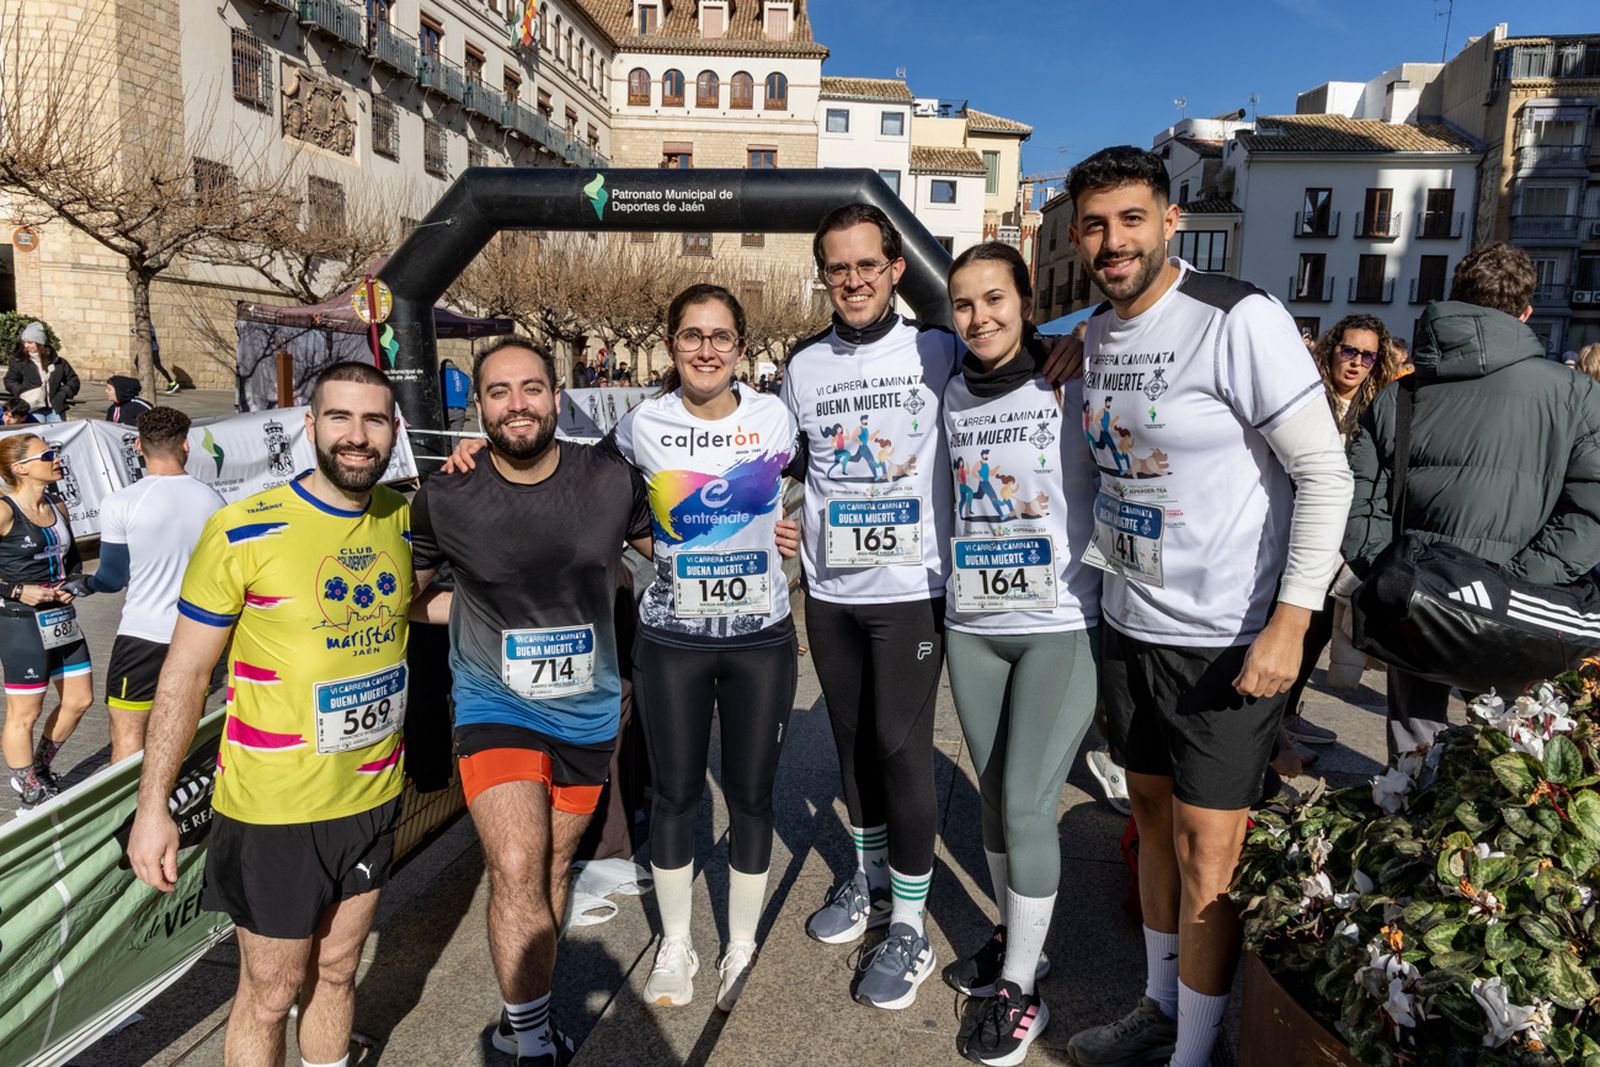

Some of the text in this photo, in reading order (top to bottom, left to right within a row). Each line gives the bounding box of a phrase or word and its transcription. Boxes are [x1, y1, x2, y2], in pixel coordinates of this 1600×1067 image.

[612, 188, 734, 202] Patronato Municipal de
[612, 201, 705, 214] Deportes de Jaén
[1122, 351, 1176, 366] CAMINATA
[816, 374, 924, 396] VI CARRERA CAMINATA
[1102, 372, 1145, 391] MUERTE
[816, 392, 901, 417] BUENA MUERTE
[956, 408, 1058, 428] CARRERA CAMINATA
[660, 426, 760, 456] calderón
[976, 426, 1028, 445] MUERTE
[877, 502, 910, 510] CAMINATA
[683, 511, 750, 525] entrénate
[838, 512, 896, 524] BUENA MUERTE
[852, 526, 897, 551] 165
[340, 546, 373, 555] CLUB
[972, 544, 1001, 552] CARRERA
[1002, 541, 1040, 550] CAMINATA
[725, 554, 758, 562] CAMINATA
[965, 552, 1025, 566] BUENA MUERTE
[686, 564, 744, 576] BUENA MUERTE
[979, 568, 1028, 595] 164
[699, 577, 747, 602] 140
[54, 621, 72, 638] 687
[326, 622, 397, 650] maristas
[523, 634, 555, 643] CARRERA
[555, 632, 586, 642] CAMINATA
[352, 648, 380, 656] JAÉN
[516, 642, 573, 656] BUENA MUERTE
[531, 657, 574, 684] 714
[339, 680, 370, 694] CARRERA
[330, 685, 388, 710] BUENA MUERTE
[343, 698, 391, 735] 569
